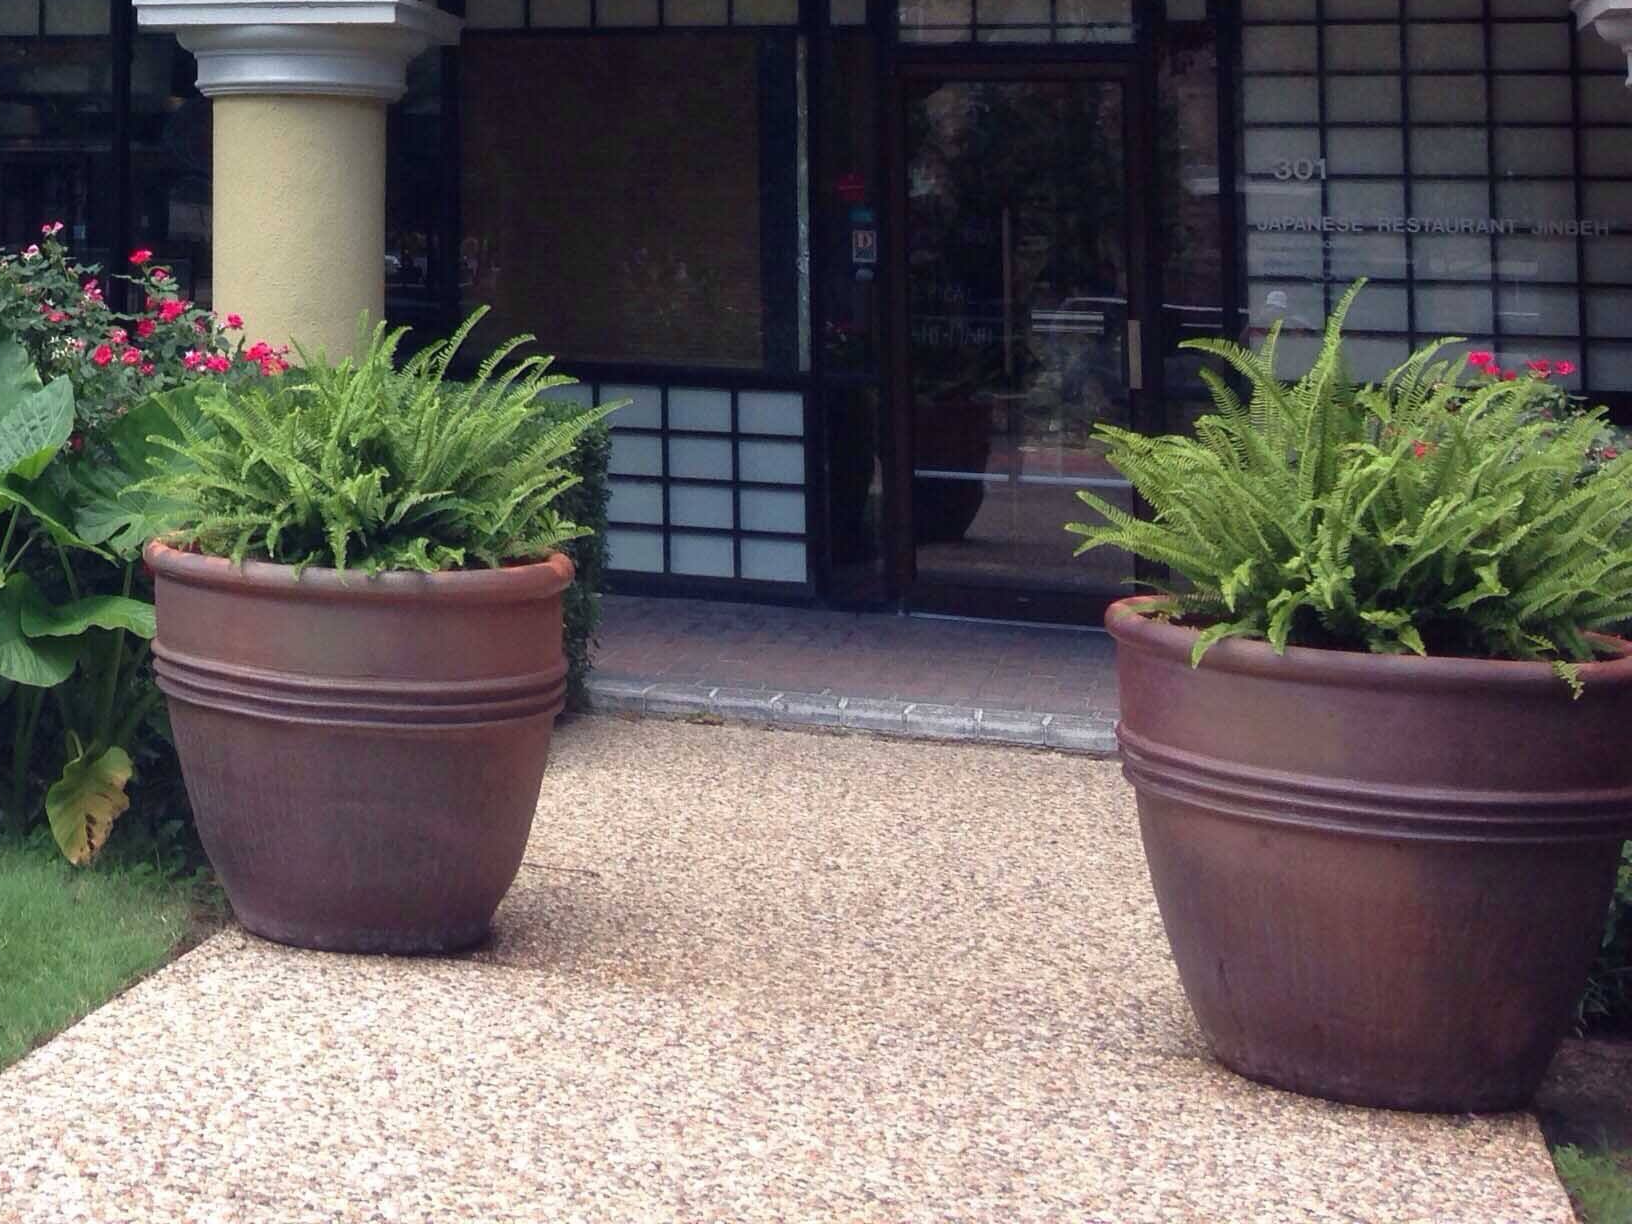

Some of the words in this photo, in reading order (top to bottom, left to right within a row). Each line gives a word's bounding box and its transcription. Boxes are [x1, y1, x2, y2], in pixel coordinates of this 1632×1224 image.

[1274, 157, 1328, 181] 301
[1256, 216, 1364, 233] JAPANESE
[1377, 217, 1519, 234] RESTAURANT
